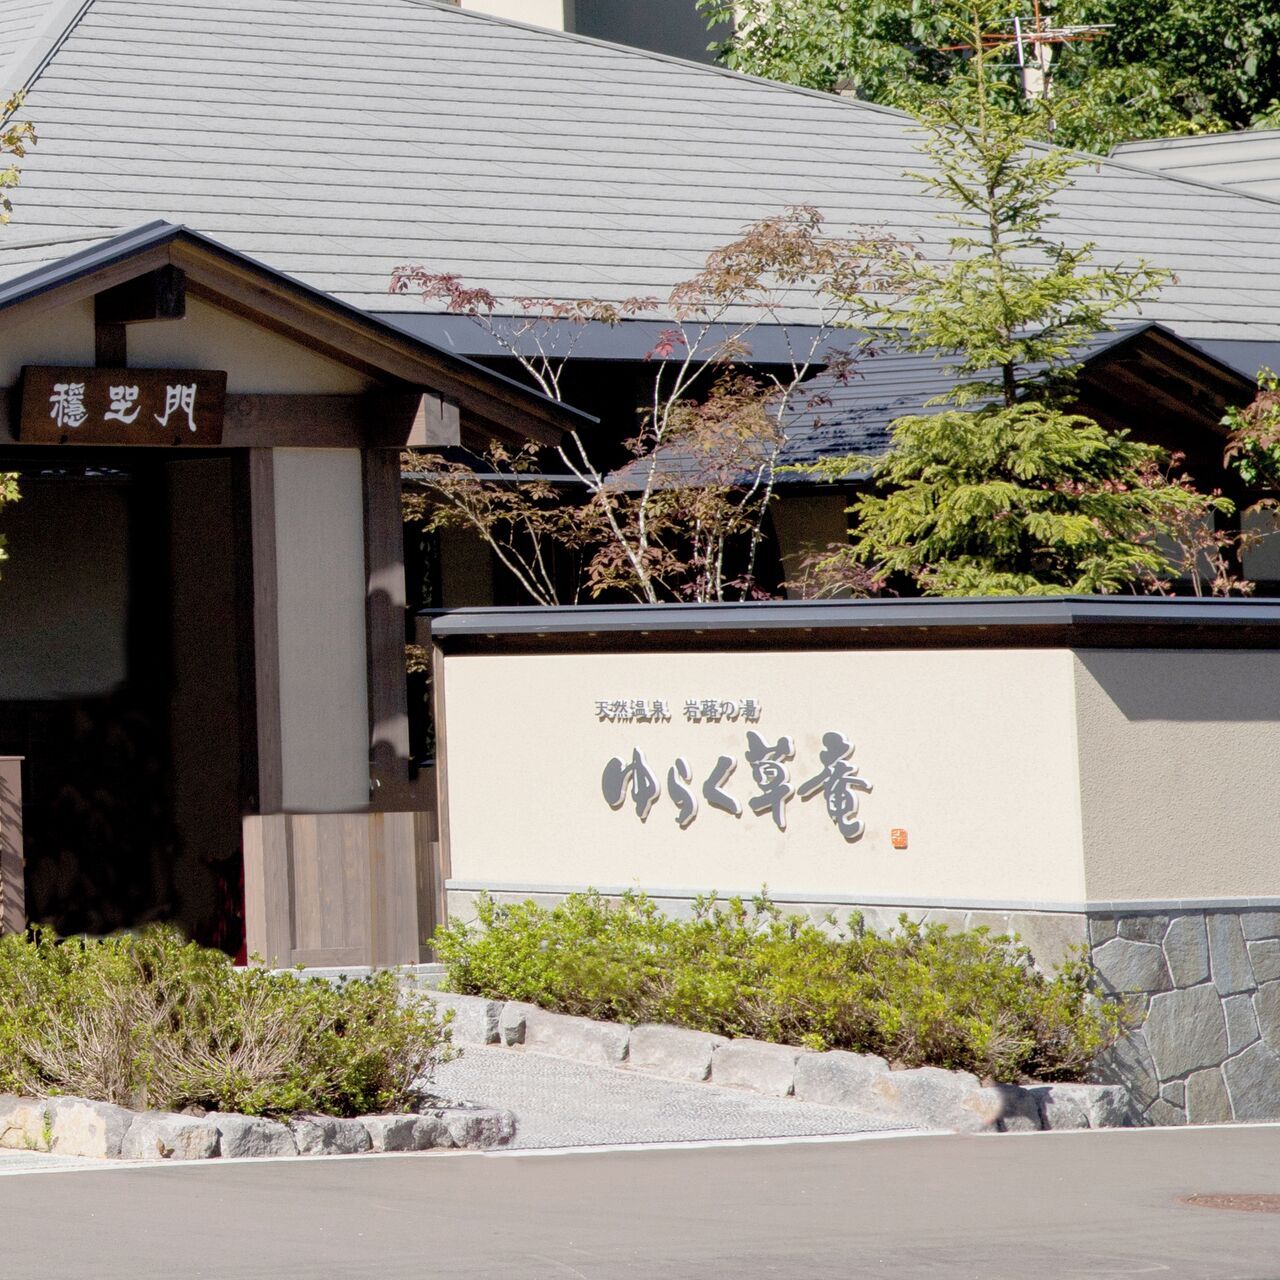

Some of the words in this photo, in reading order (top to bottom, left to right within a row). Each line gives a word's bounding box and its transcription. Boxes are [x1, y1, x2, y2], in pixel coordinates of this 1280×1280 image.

[594, 699, 669, 720] 天然温泉
[601, 730, 873, 839] ゆらく草庵
